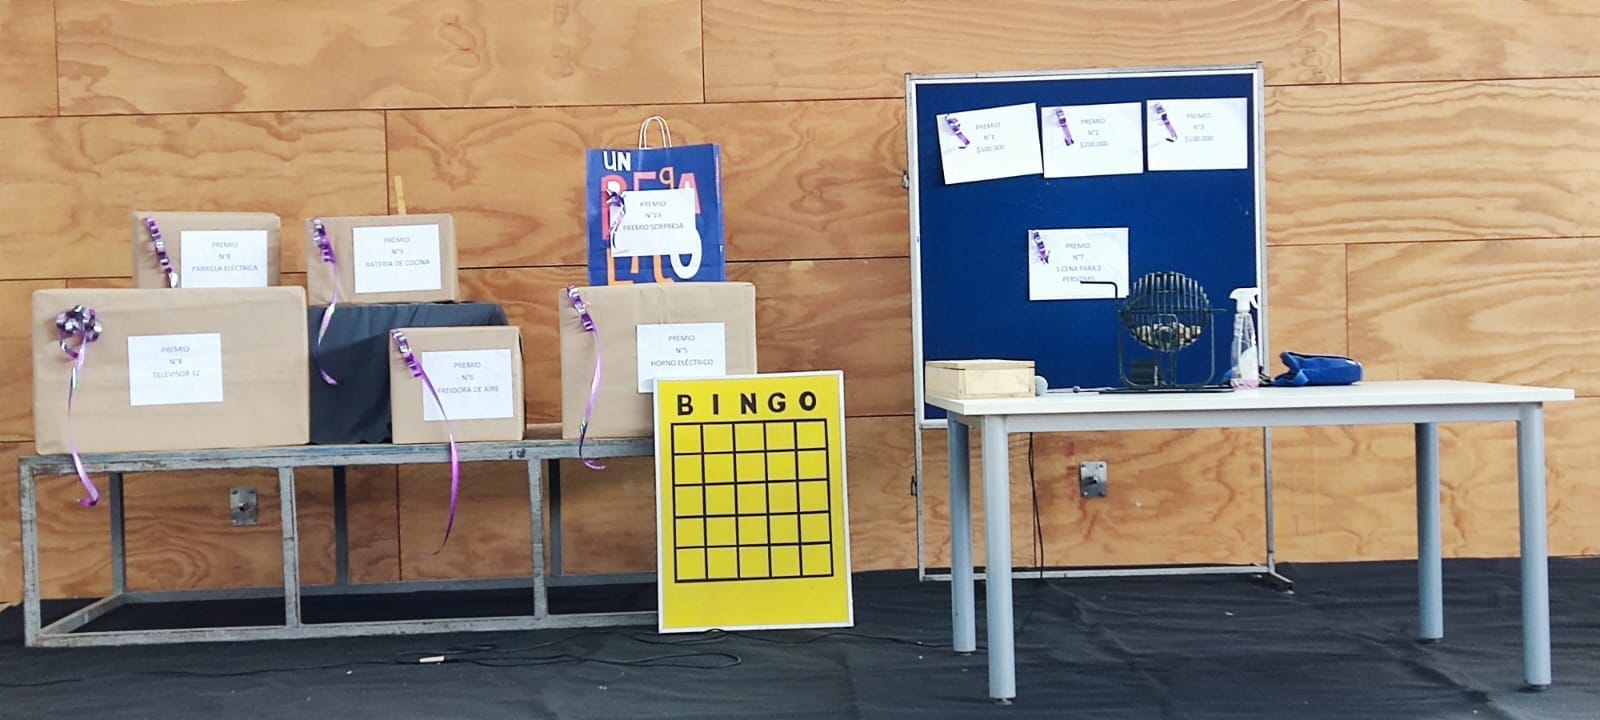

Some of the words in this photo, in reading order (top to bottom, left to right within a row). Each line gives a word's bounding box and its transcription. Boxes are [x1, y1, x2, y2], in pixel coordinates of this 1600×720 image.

[976, 122, 1001, 130] PREMIO
[603, 150, 632, 172] UN
[640, 200, 667, 208] PREMIO
[623, 223, 649, 231] PREMIO
[650, 222, 684, 230] SORPRESA
[383, 236, 411, 244] PREMIO
[211, 241, 239, 249] PREMIO
[1080, 264, 1096, 272] PARA
[668, 334, 696, 342] PREMIO
[160, 345, 190, 353] PREMIO
[453, 361, 481, 369] PREMIO
[651, 359, 677, 367] HORNO
[678, 358, 714, 366] ELÉCTRICO
[152, 370, 190, 379] TELEVISOR
[437, 386, 472, 394] FREIDORA
[473, 385, 482, 393] DE
[483, 385, 499, 393] AIRE
[676, 390, 817, 416] BINGO
